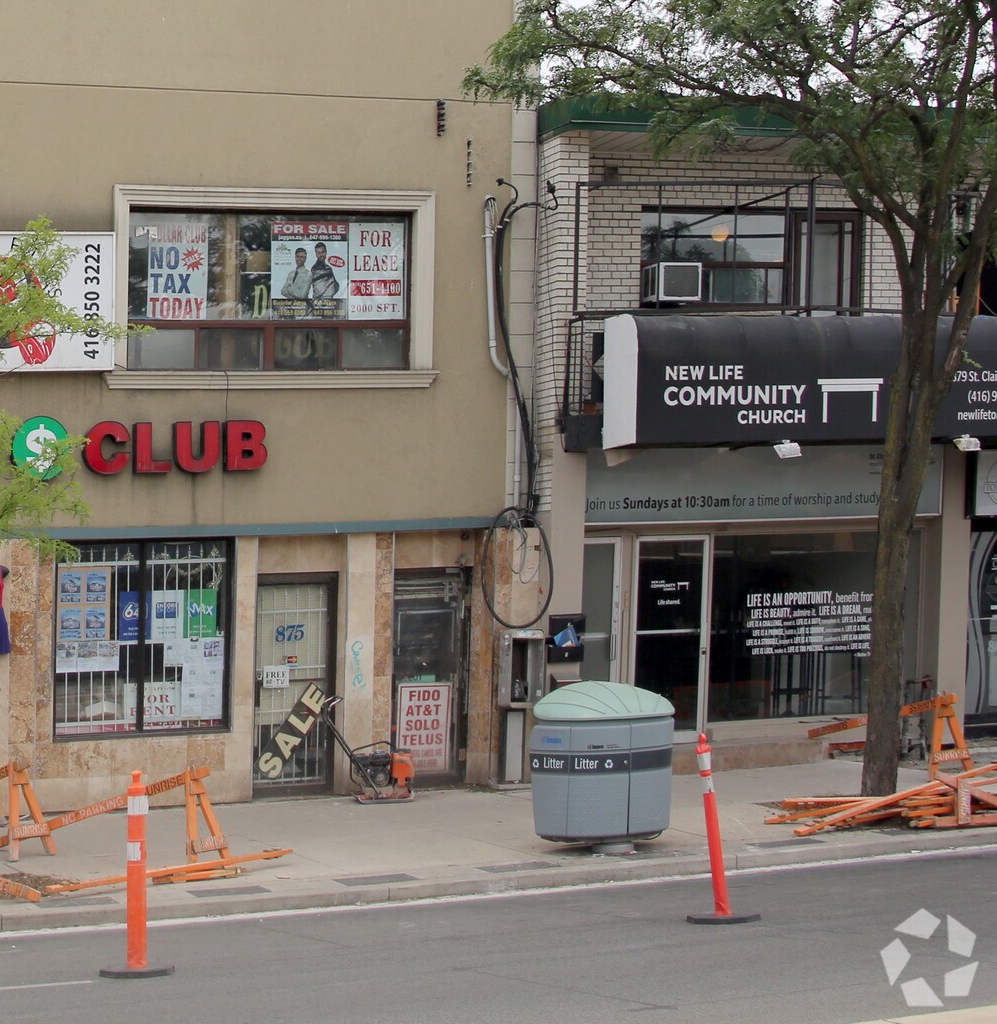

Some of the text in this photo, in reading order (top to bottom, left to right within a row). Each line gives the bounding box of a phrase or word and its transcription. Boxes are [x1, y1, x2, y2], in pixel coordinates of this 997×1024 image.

[186, 224, 206, 243] CLUB
[274, 224, 345, 233] FOR SALE
[360, 230, 391, 247] FOR
[84, 243, 100, 285] 3222
[150, 246, 180, 269] NO
[354, 255, 398, 271] LEASE
[150, 274, 191, 293] TAX
[149, 298, 204, 319] TODAY
[351, 304, 373, 313] 2000
[376, 303, 400, 313] SFT.
[665, 365, 744, 380] NEW LIFE
[968, 371, 980, 382] St.
[664, 384, 806, 406] COMMUNITY
[967, 390, 990, 404] (416)
[737, 409, 806, 424] CHURCH
[81, 419, 268, 476] CLUB
[585, 491, 882, 514] Join us Sundays at 10:30am for a time of worship and study
[747, 590, 859, 607] LIFE IS AN OPPORTUNITY, benefit
[751, 608, 762, 619] LIFE
[763, 608, 769, 618] IS
[770, 607, 792, 618] BEAUTY,
[793, 608, 811, 617] admire
[819, 606, 831, 616] LIFE
[831, 605, 837, 615] IS
[837, 605, 841, 615] A
[842, 604, 862, 615] DREAM,
[275, 624, 305, 642] 875
[752, 647, 760, 655] LIFE
[787, 645, 795, 653] LIFE
[266, 671, 286, 679] FREE
[146, 694, 170, 704] OR
[409, 689, 441, 702] FIDO
[406, 704, 441, 717] AT&T
[258, 683, 325, 779] SALE
[405, 719, 440, 731] SOLO
[402, 733, 443, 746] TELUS
[933, 749, 969, 761] SUNRISE
[543, 757, 564, 769] Litter
[574, 757, 599, 769] Litter
[145, 775, 183, 796] UNRISE
[79, 796, 124, 819] PARKING
[14, 823, 49, 837] SUNRISE
